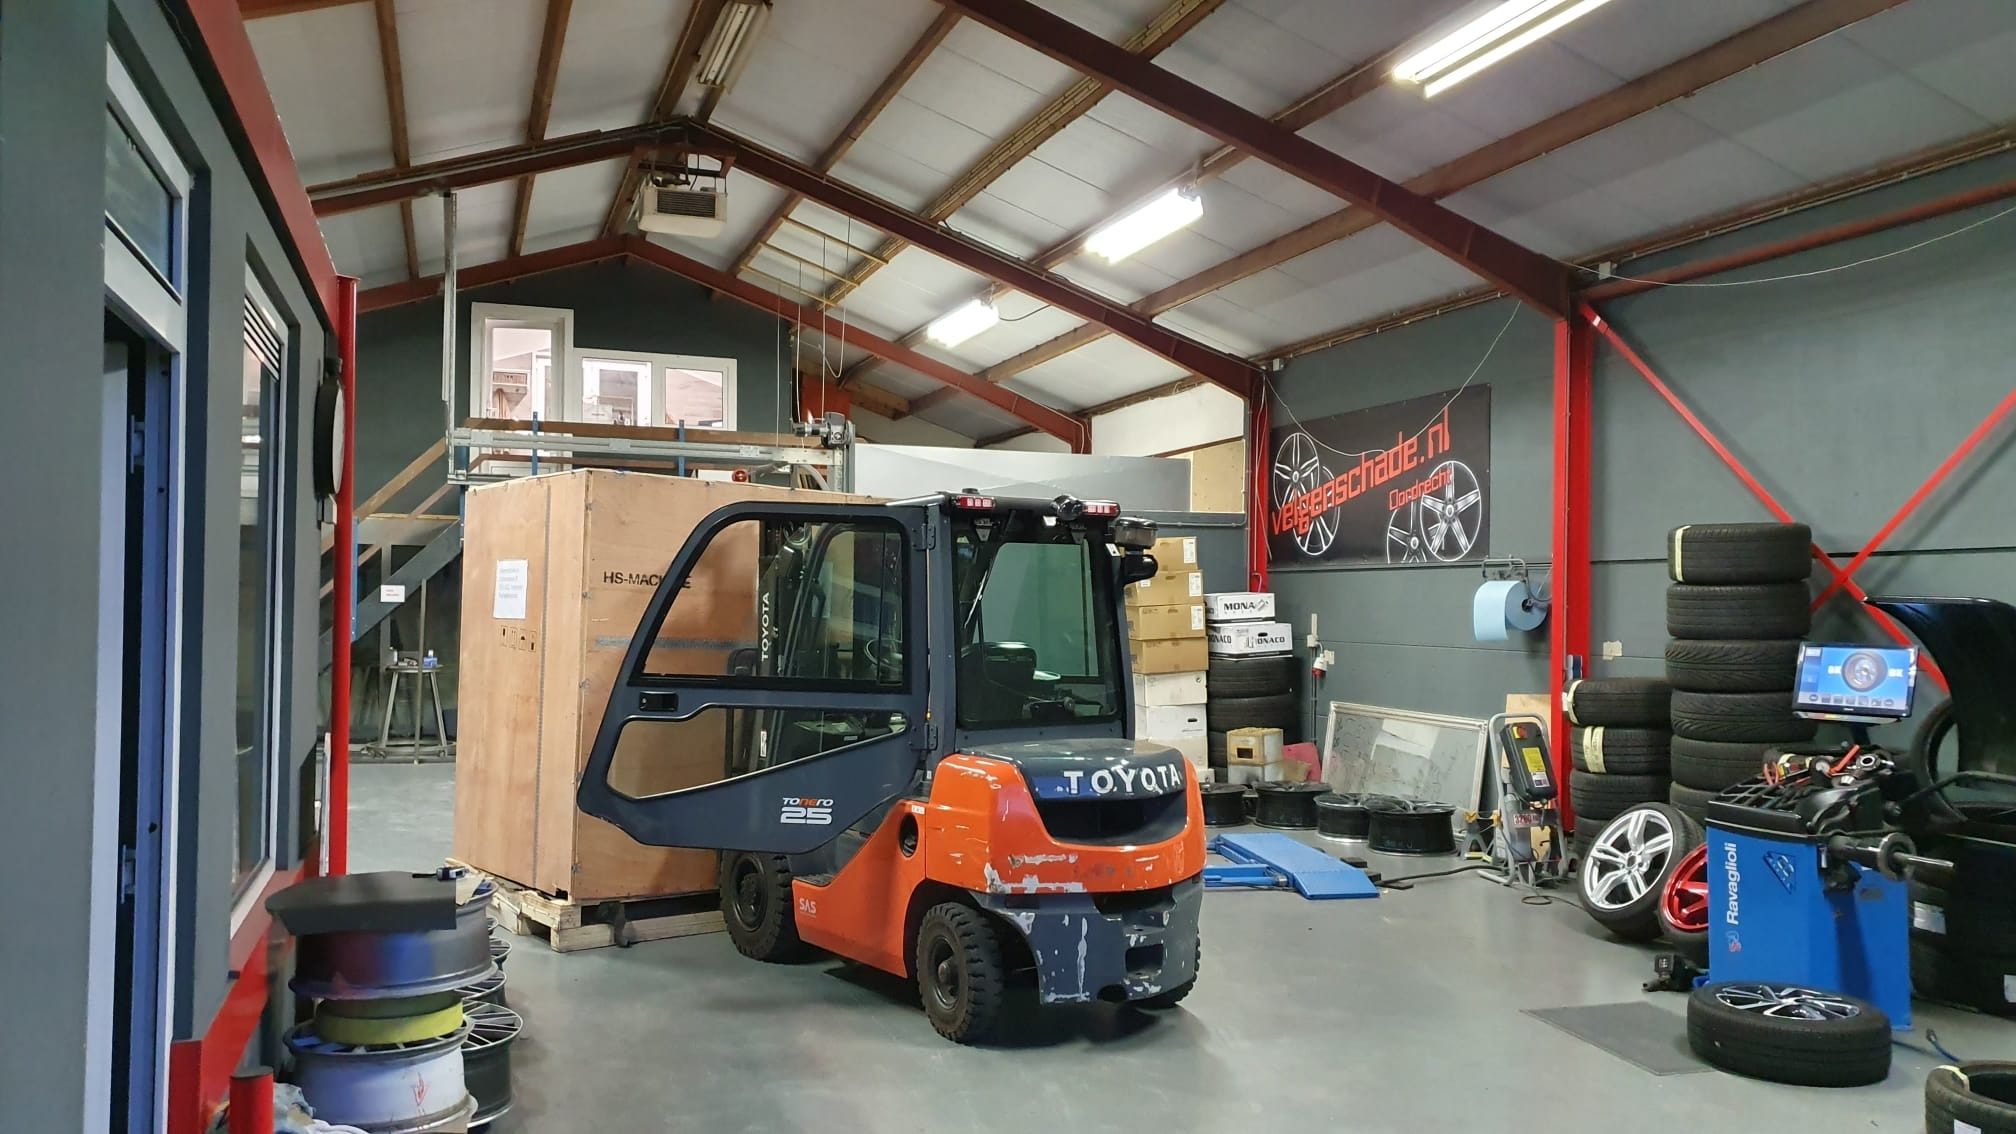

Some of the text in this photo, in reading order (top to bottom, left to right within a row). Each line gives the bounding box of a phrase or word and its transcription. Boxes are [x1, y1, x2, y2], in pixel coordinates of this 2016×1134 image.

[1389, 466, 1452, 511] Dordrecht
[761, 592, 769, 661] TOYOTA
[1063, 763, 1181, 794] TOYOTA
[780, 806, 832, 825] 25
[1724, 842, 1740, 925] Ravaglioli
[800, 897, 817, 914] SAS
